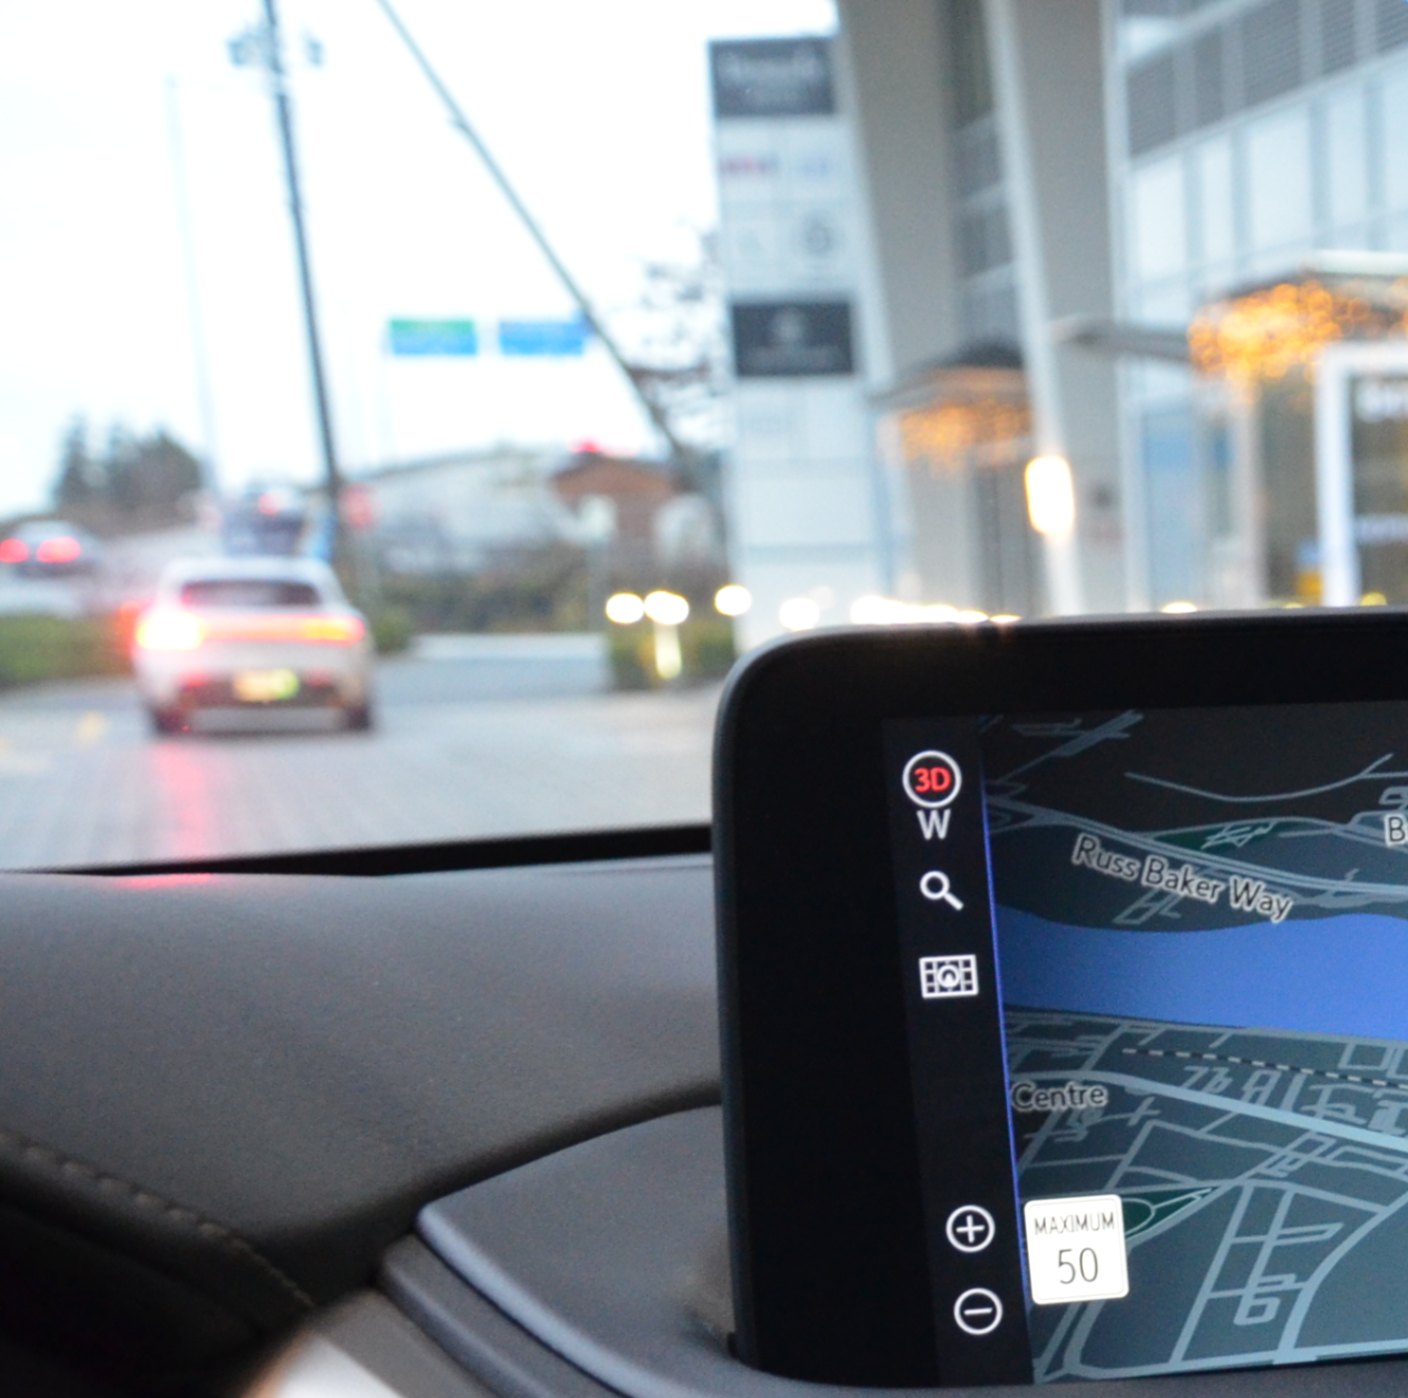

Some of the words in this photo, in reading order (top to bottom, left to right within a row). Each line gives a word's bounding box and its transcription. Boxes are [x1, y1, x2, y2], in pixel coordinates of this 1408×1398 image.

[913, 767, 951, 792] 3D
[917, 809, 951, 840] W
[1073, 832, 1138, 881] Russ
[1142, 856, 1220, 906] Baker
[1229, 878, 1292, 923] Way
[1011, 1081, 1108, 1112] Centre
[1033, 1212, 1116, 1236] MAXIMUM
[1057, 1247, 1100, 1285] 50
